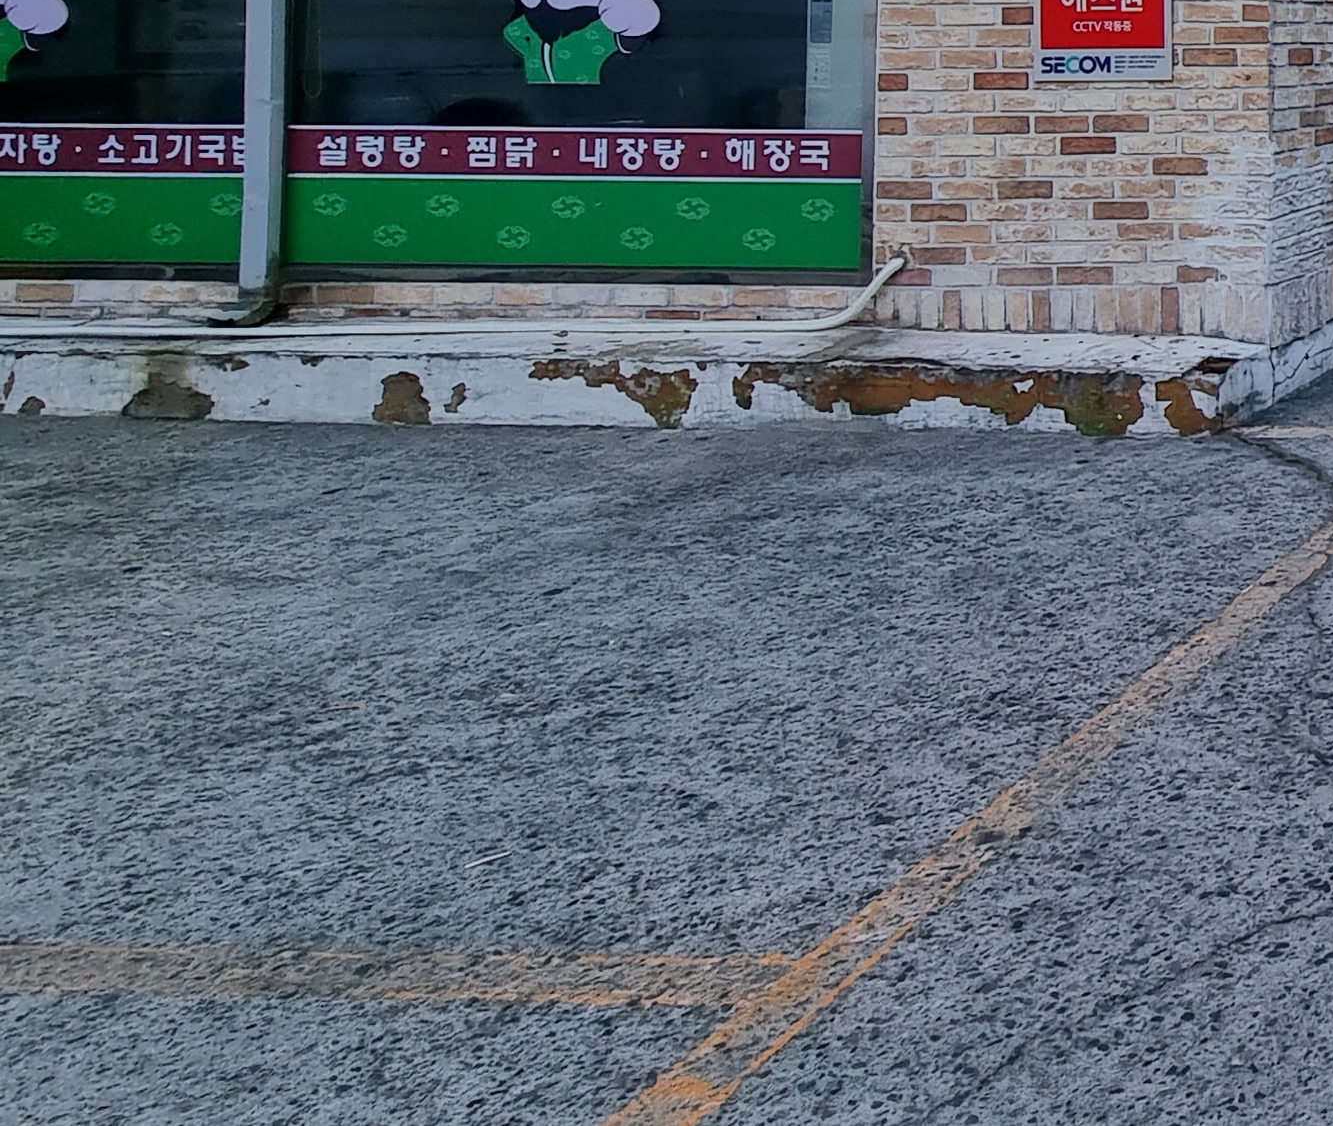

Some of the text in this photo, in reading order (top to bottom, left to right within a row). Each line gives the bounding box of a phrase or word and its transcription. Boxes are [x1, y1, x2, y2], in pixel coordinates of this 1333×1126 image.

[1072, 20, 1133, 32] CCTV 작동중
[1041, 55, 1111, 74] SECOM
[316, 135, 830, 172] 설렁탕 찜닭 내장탕 해장국
